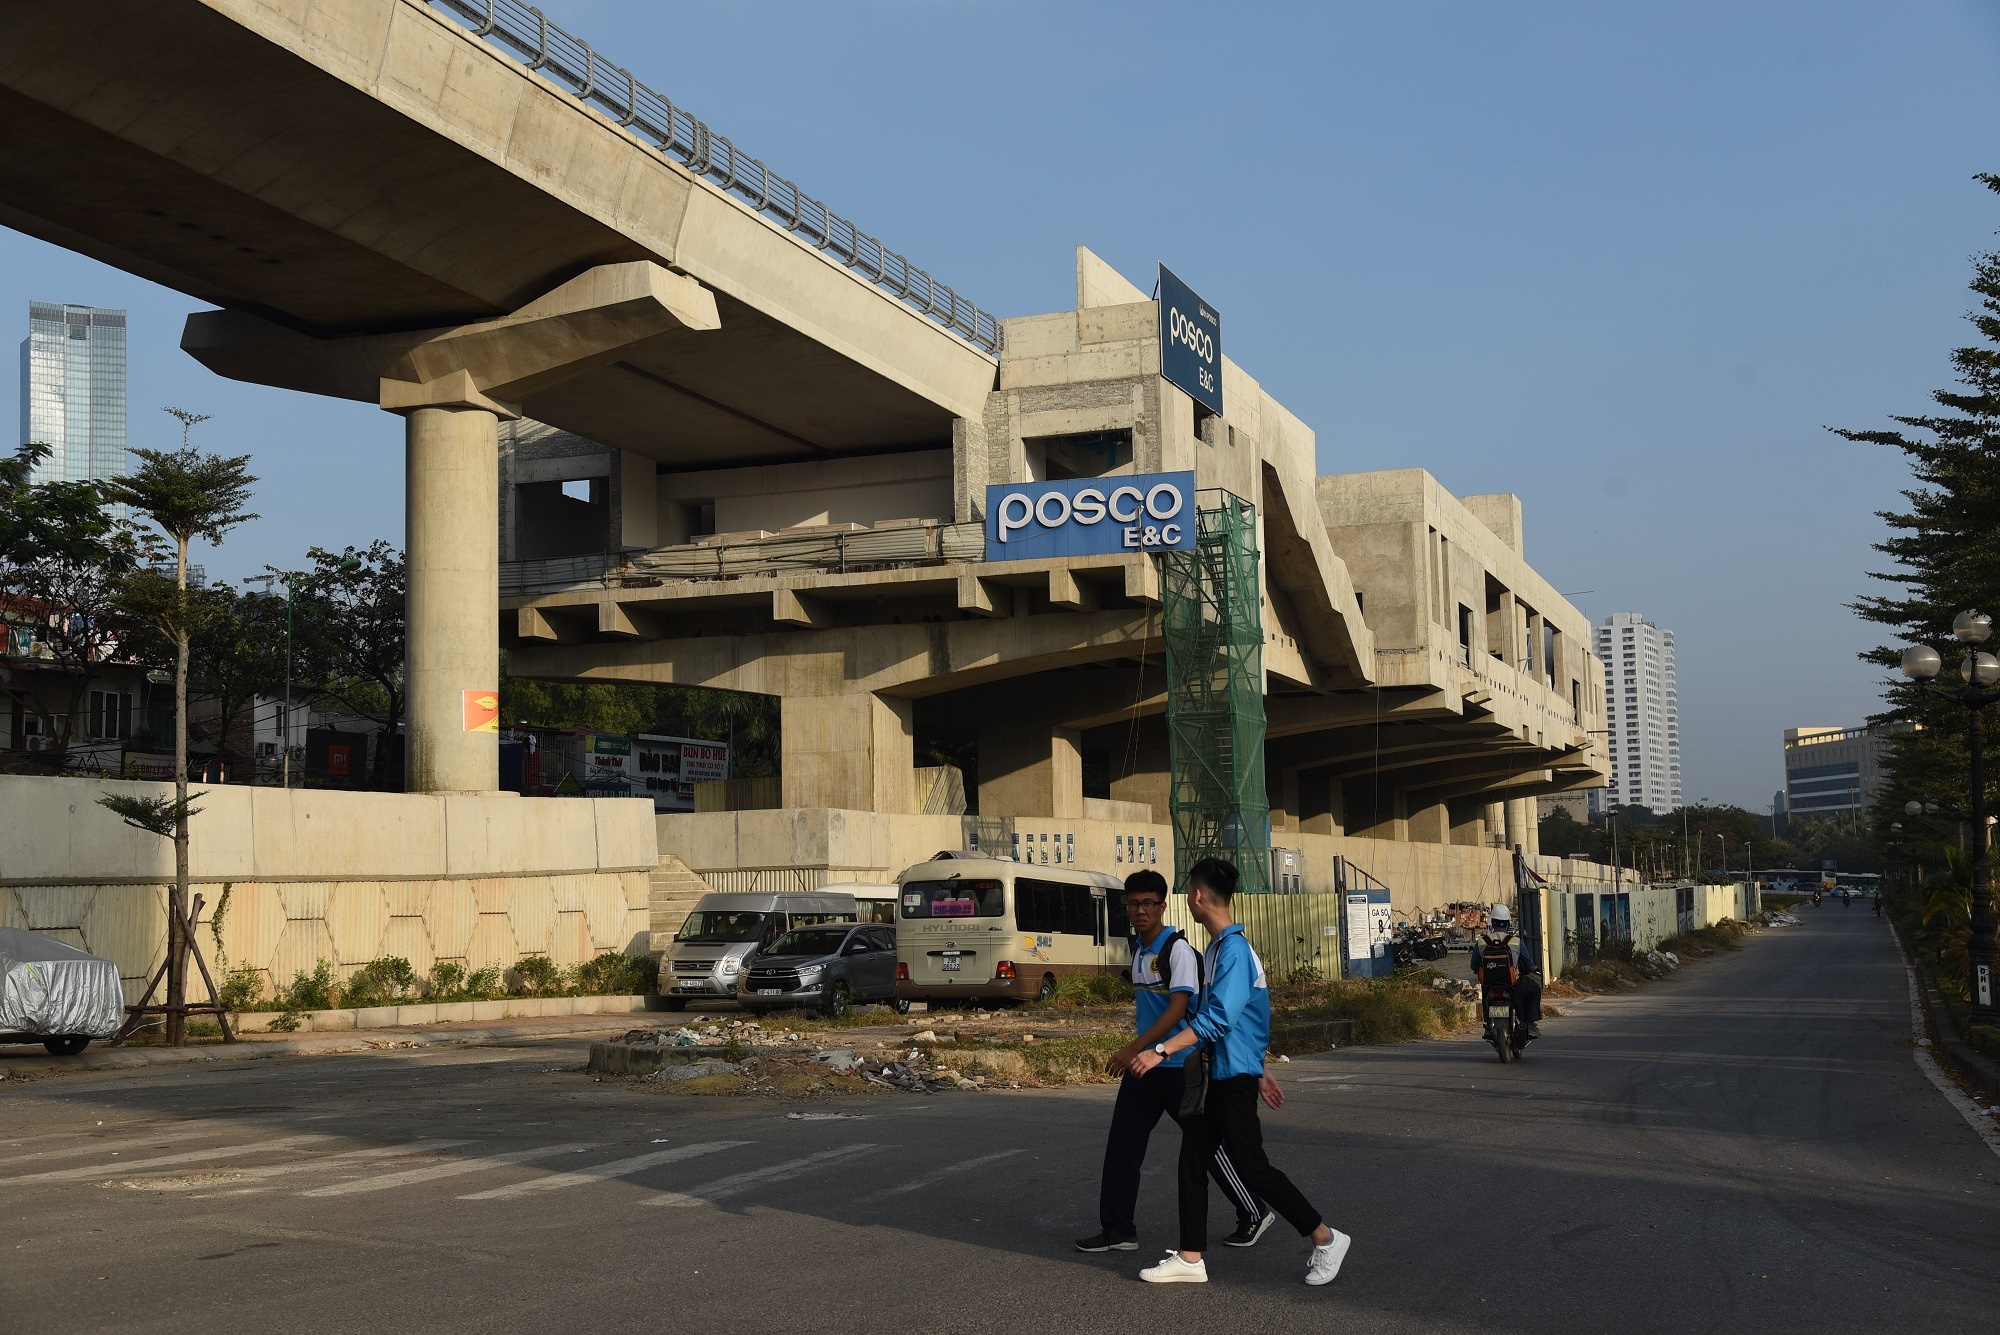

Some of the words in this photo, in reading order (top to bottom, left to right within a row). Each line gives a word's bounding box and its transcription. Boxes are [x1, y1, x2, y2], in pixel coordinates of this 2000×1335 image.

[1199, 366, 1214, 394] E&C
[1123, 523, 1182, 548] E&C
[922, 924, 980, 932] HYUNDAI
